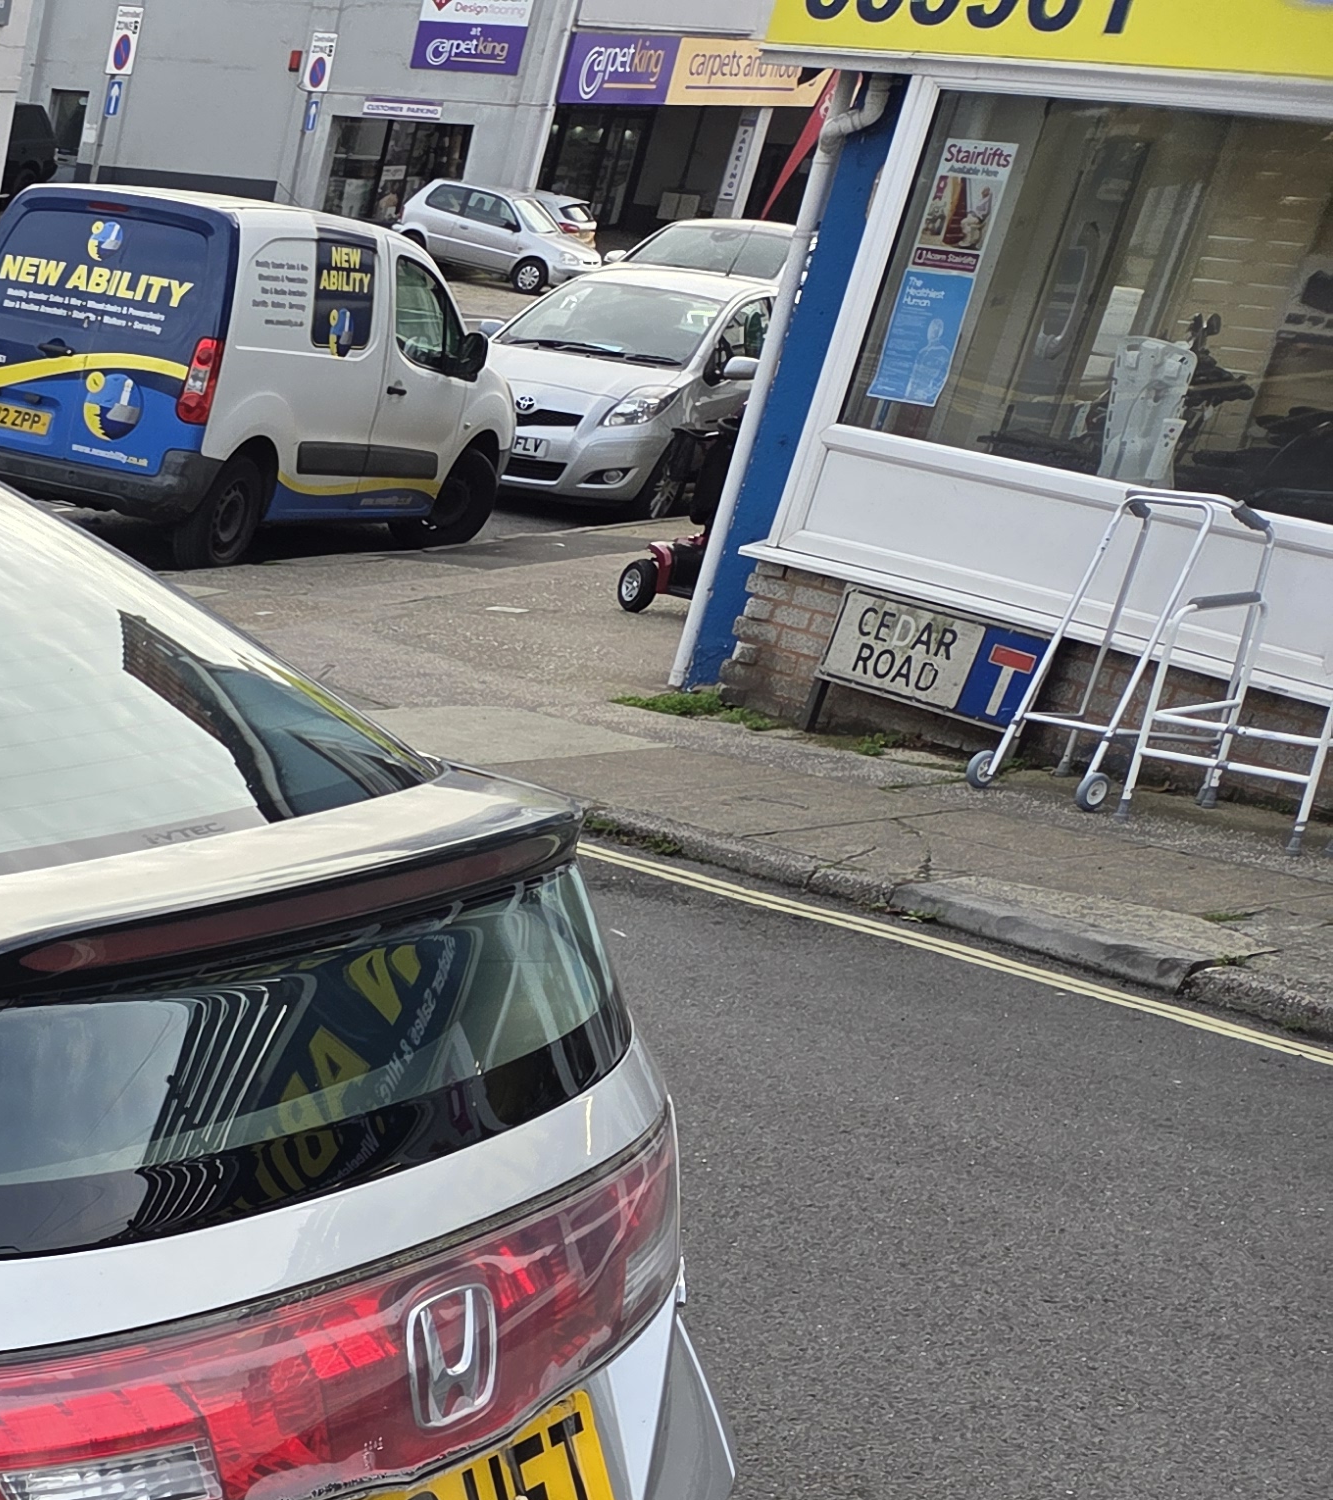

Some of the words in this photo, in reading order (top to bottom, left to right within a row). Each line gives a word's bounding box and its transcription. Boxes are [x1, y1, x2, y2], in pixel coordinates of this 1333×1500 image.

[470, 27, 482, 36] at
[689, 50, 741, 83] carpets
[366, 104, 403, 112] CUSTOMER
[406, 107, 439, 115] PARKING
[944, 143, 1012, 168] Stairlifts
[331, 246, 361, 269] NEW
[65, 264, 194, 307] ABILITY
[319, 269, 371, 293] ABILITY
[909, 276, 923, 287] The
[11, 410, 42, 430] ZPP
[858, 607, 958, 660] CEDAR
[852, 642, 938, 691] ROAD
